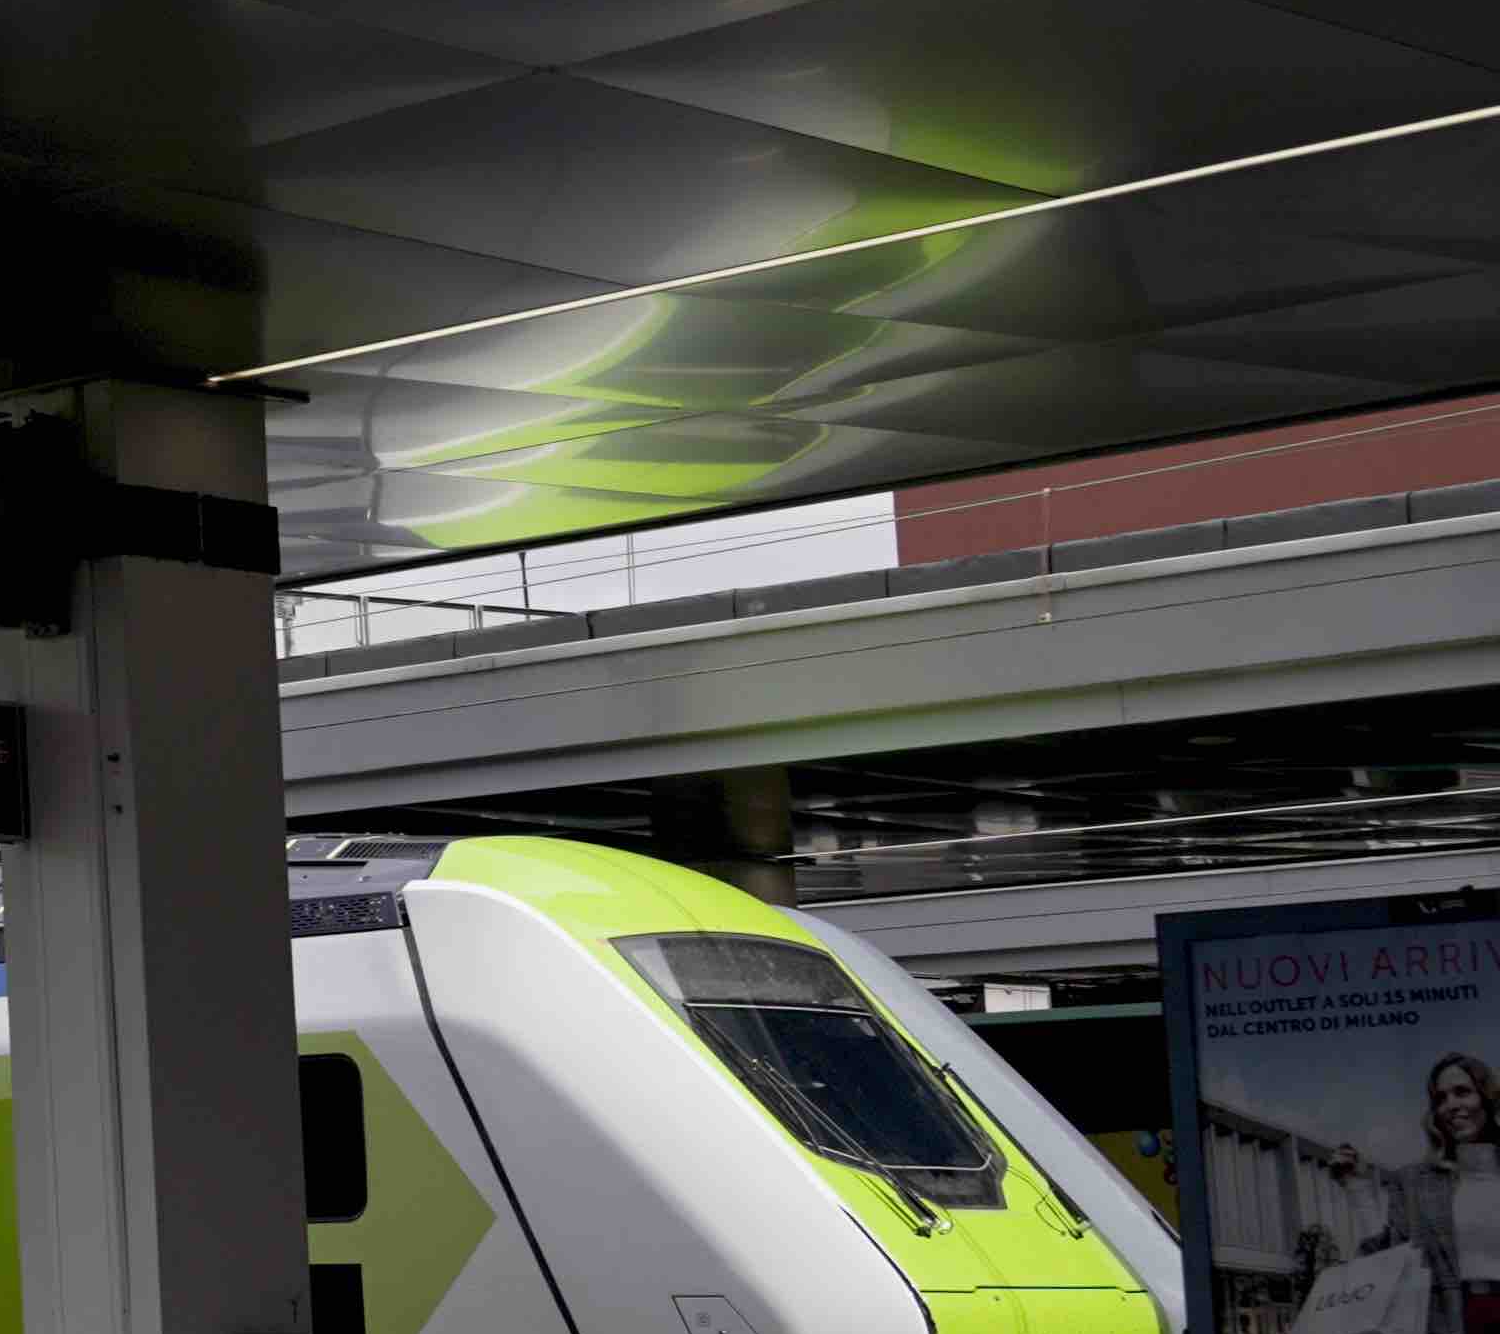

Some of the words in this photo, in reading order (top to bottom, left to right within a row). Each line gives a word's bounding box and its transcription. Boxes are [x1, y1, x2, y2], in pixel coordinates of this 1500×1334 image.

[1203, 950, 1349, 991] NUOVI
[1205, 996, 1317, 1017] NELL'OUTLET
[1323, 995, 1335, 1009] A
[1339, 992, 1379, 1008] SOLI
[1384, 990, 1405, 1005] 15
[1410, 984, 1479, 1002] MINUTI
[1207, 1023, 1238, 1038] DAL
[1243, 1017, 1316, 1035] CENTRO
[1321, 1016, 1341, 1031] DI
[1345, 1010, 1420, 1028] MILANO
